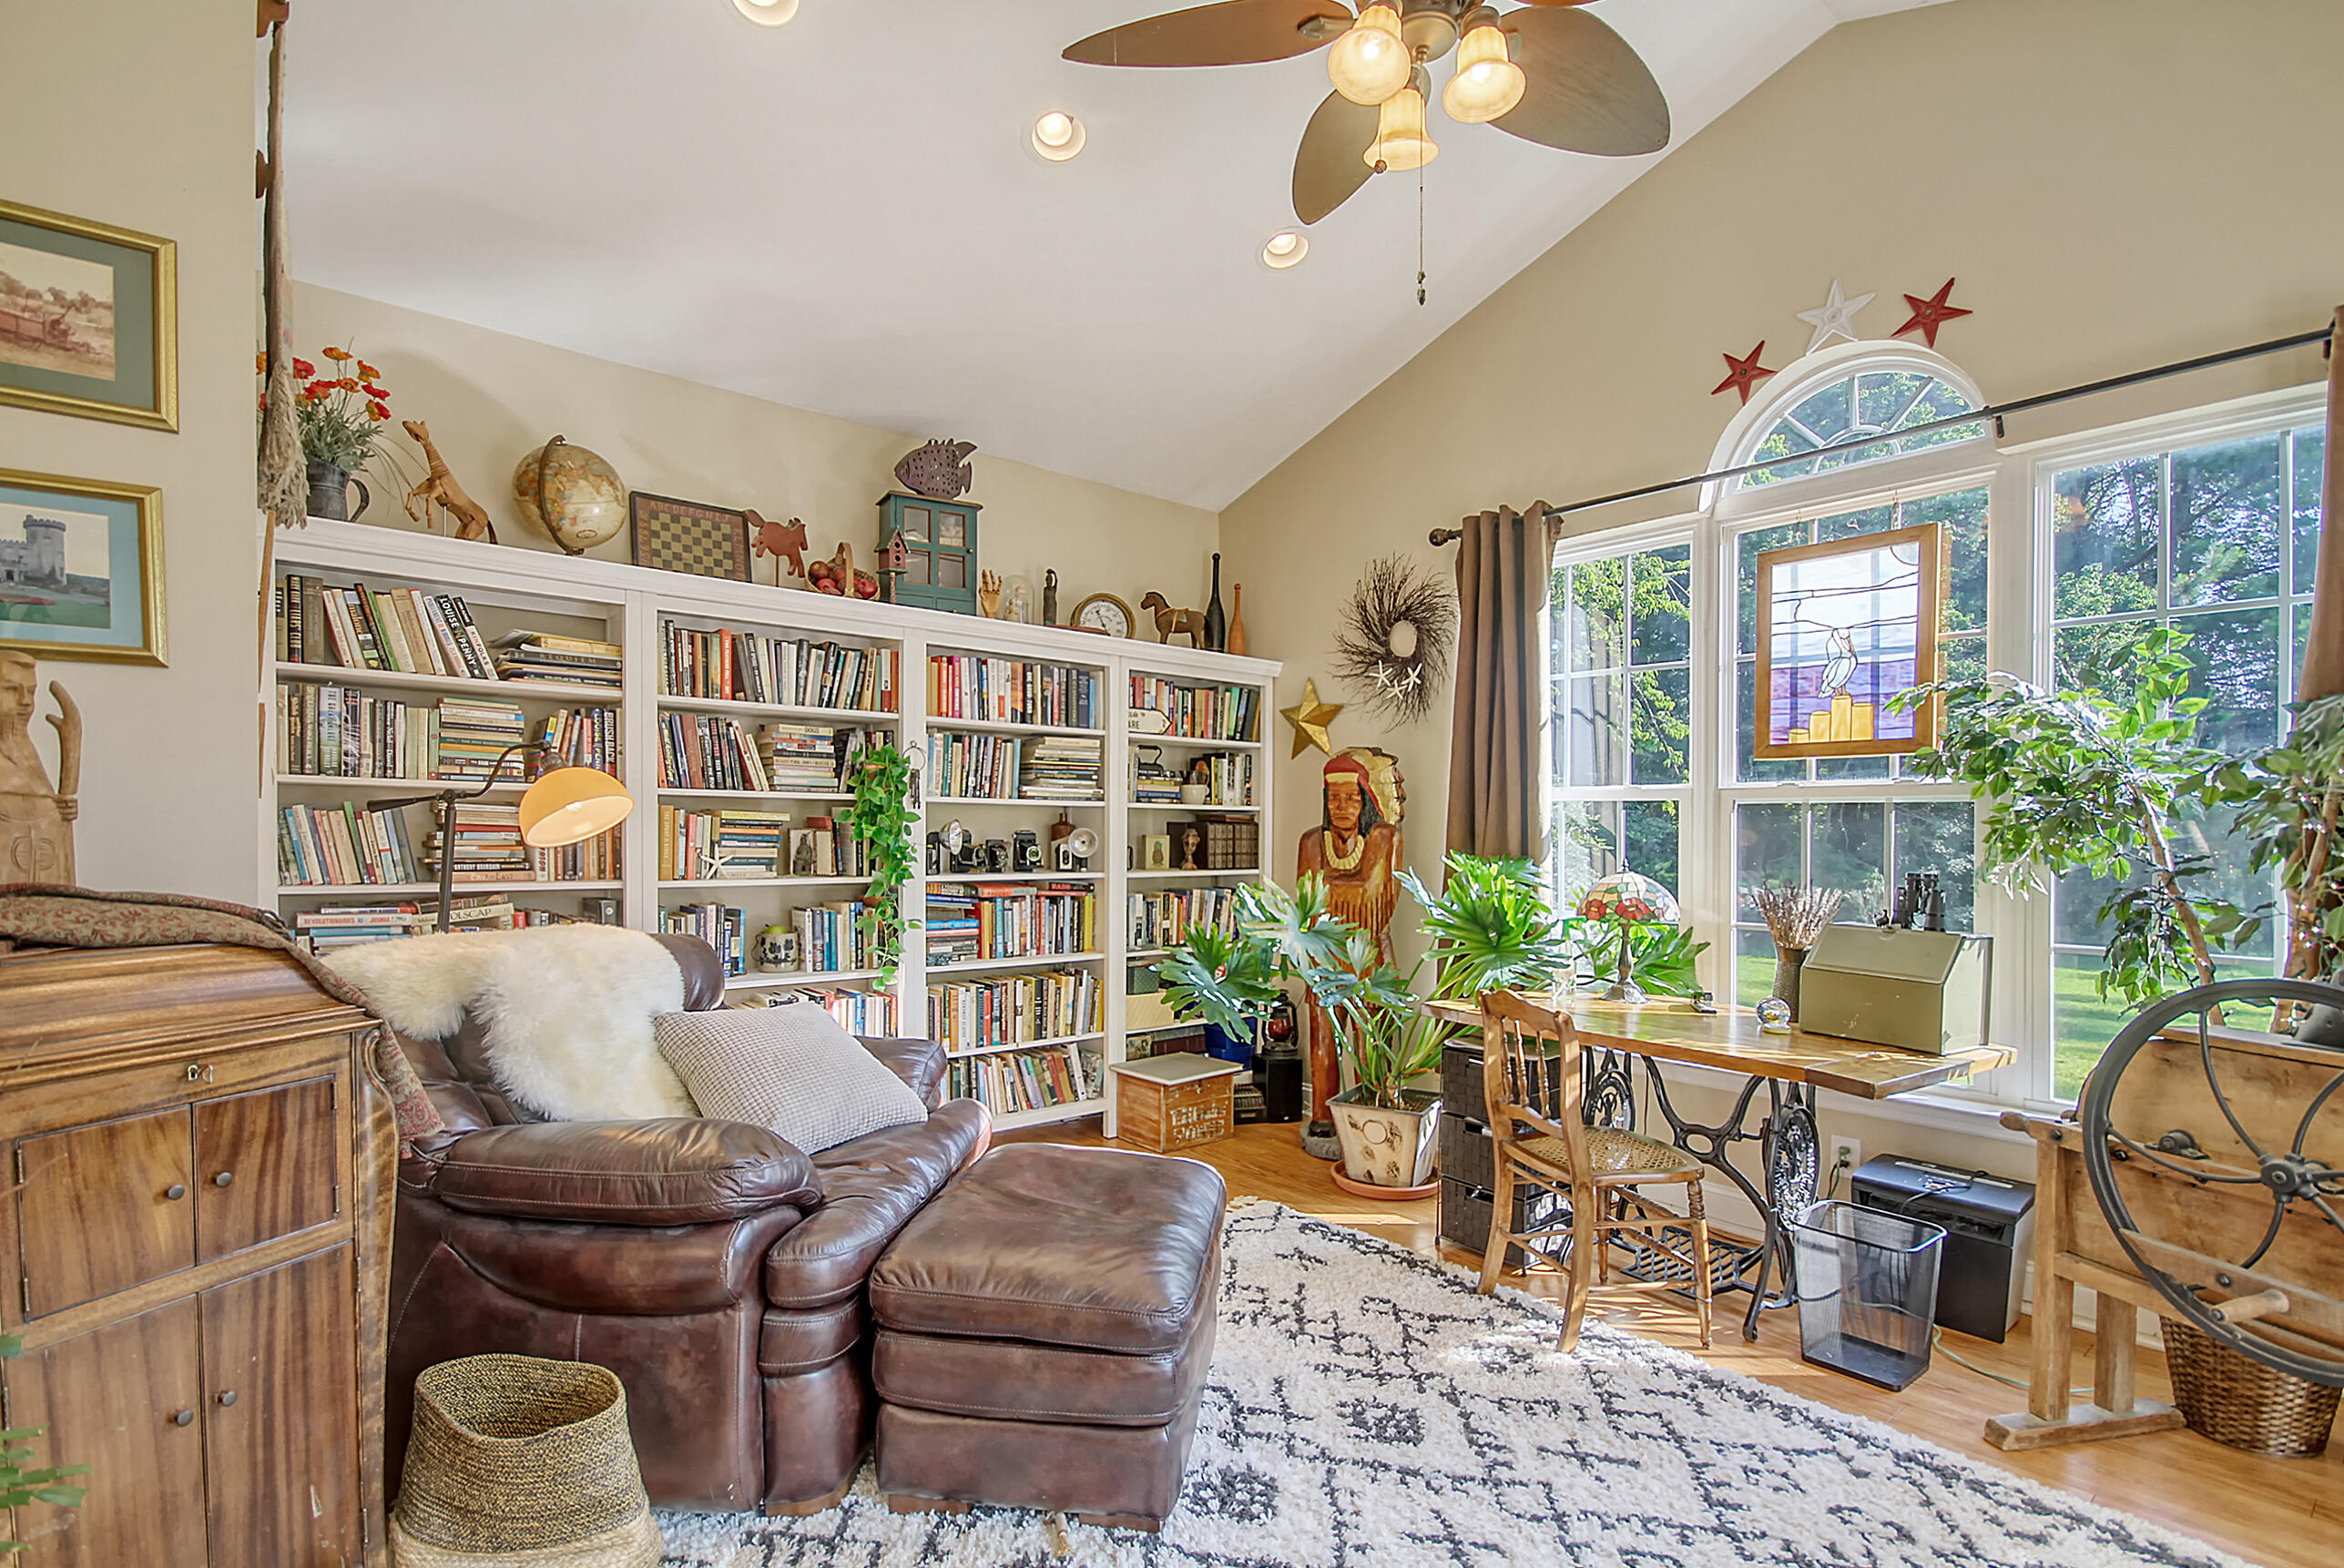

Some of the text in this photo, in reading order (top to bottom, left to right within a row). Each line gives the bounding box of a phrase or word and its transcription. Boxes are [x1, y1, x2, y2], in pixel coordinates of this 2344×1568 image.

[440, 596, 459, 628] LOUISE
[458, 636, 477, 667] PENNY
[469, 630, 491, 667] KINFOLKS
[539, 654, 596, 665] REQUIEM
[594, 713, 603, 769] LOUISE PENN
[605, 712, 617, 763] BRUSH BACK
[303, 917, 355, 925] REVOLUTIONARIES
